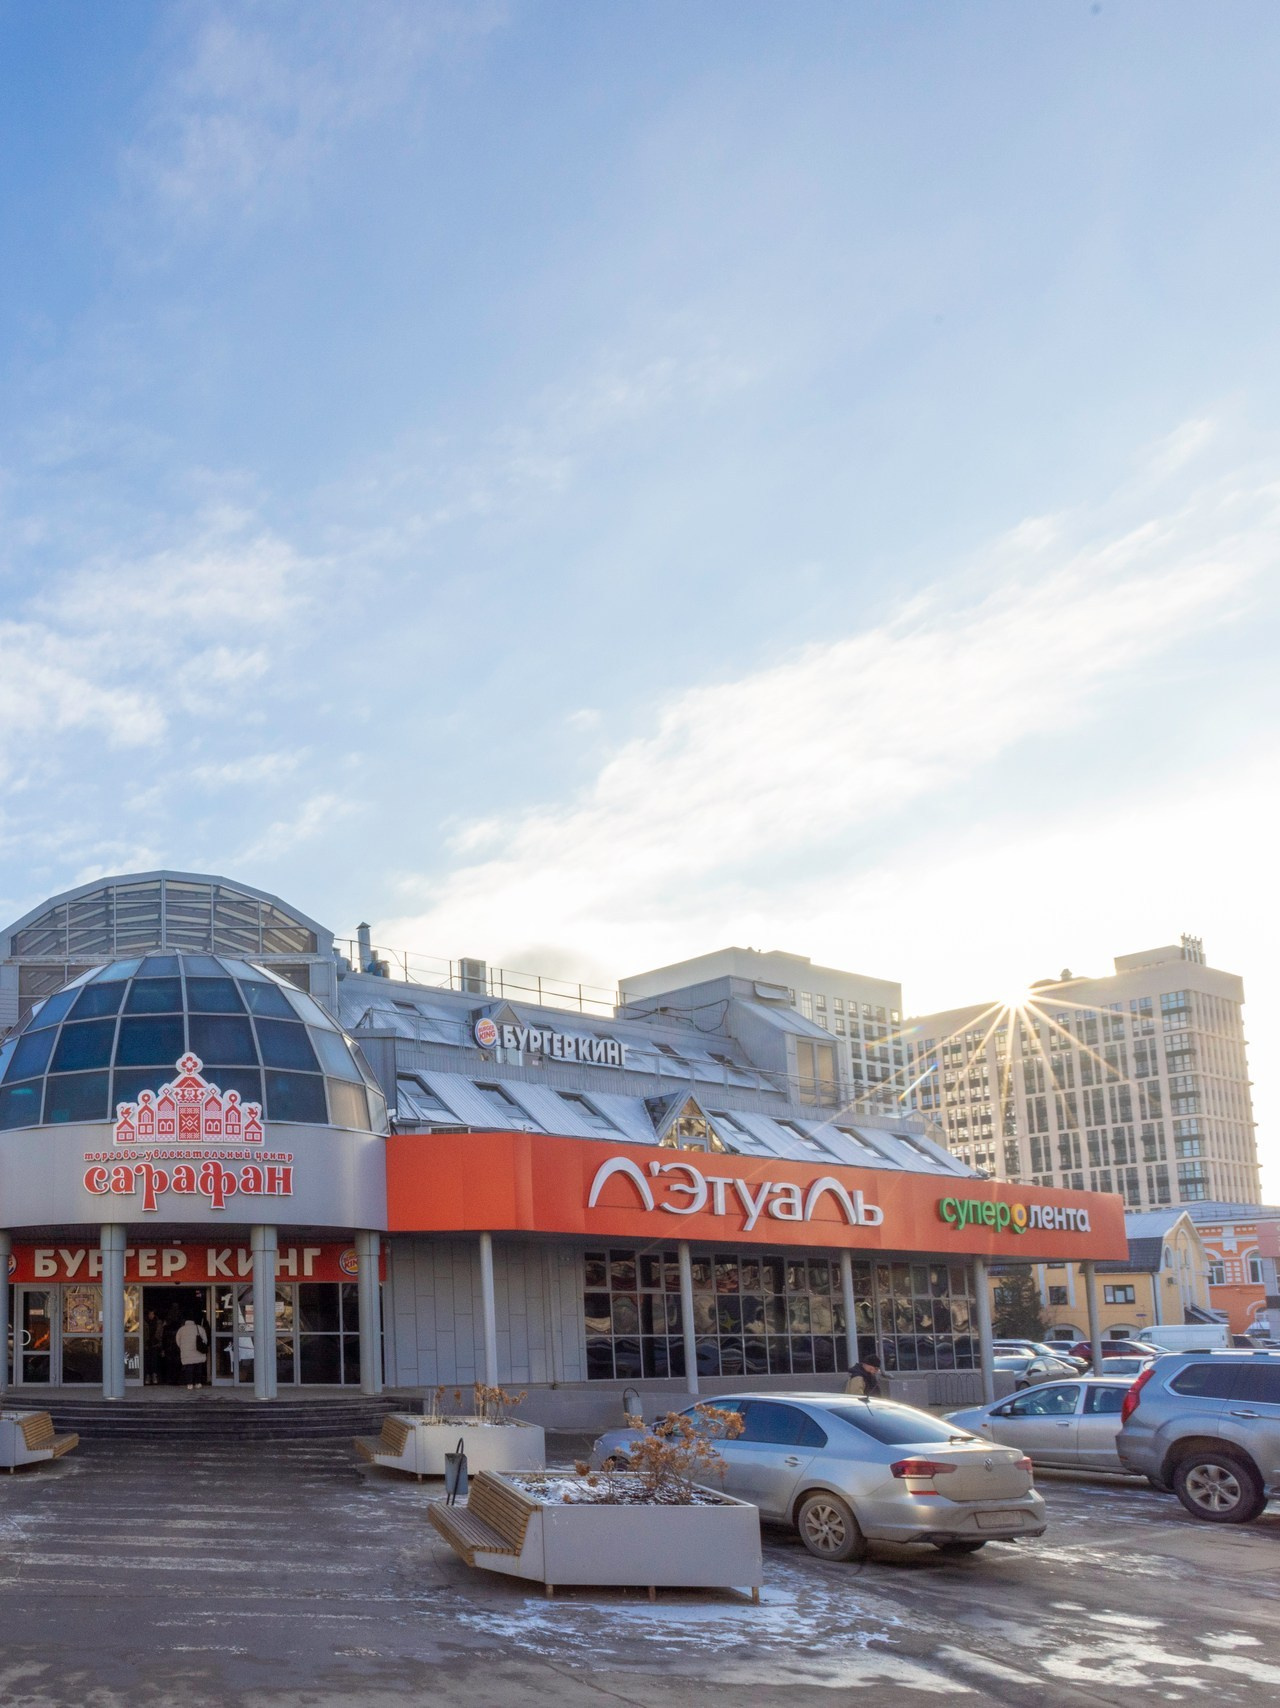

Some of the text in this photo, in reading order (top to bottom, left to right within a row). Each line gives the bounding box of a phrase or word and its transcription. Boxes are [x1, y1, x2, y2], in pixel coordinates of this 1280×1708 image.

[479, 1030, 496, 1040] KING
[502, 1025, 628, 1066] БУРГЕР КИНГ
[255, 1150, 294, 1163] центр
[83, 1160, 294, 1211] сарафан
